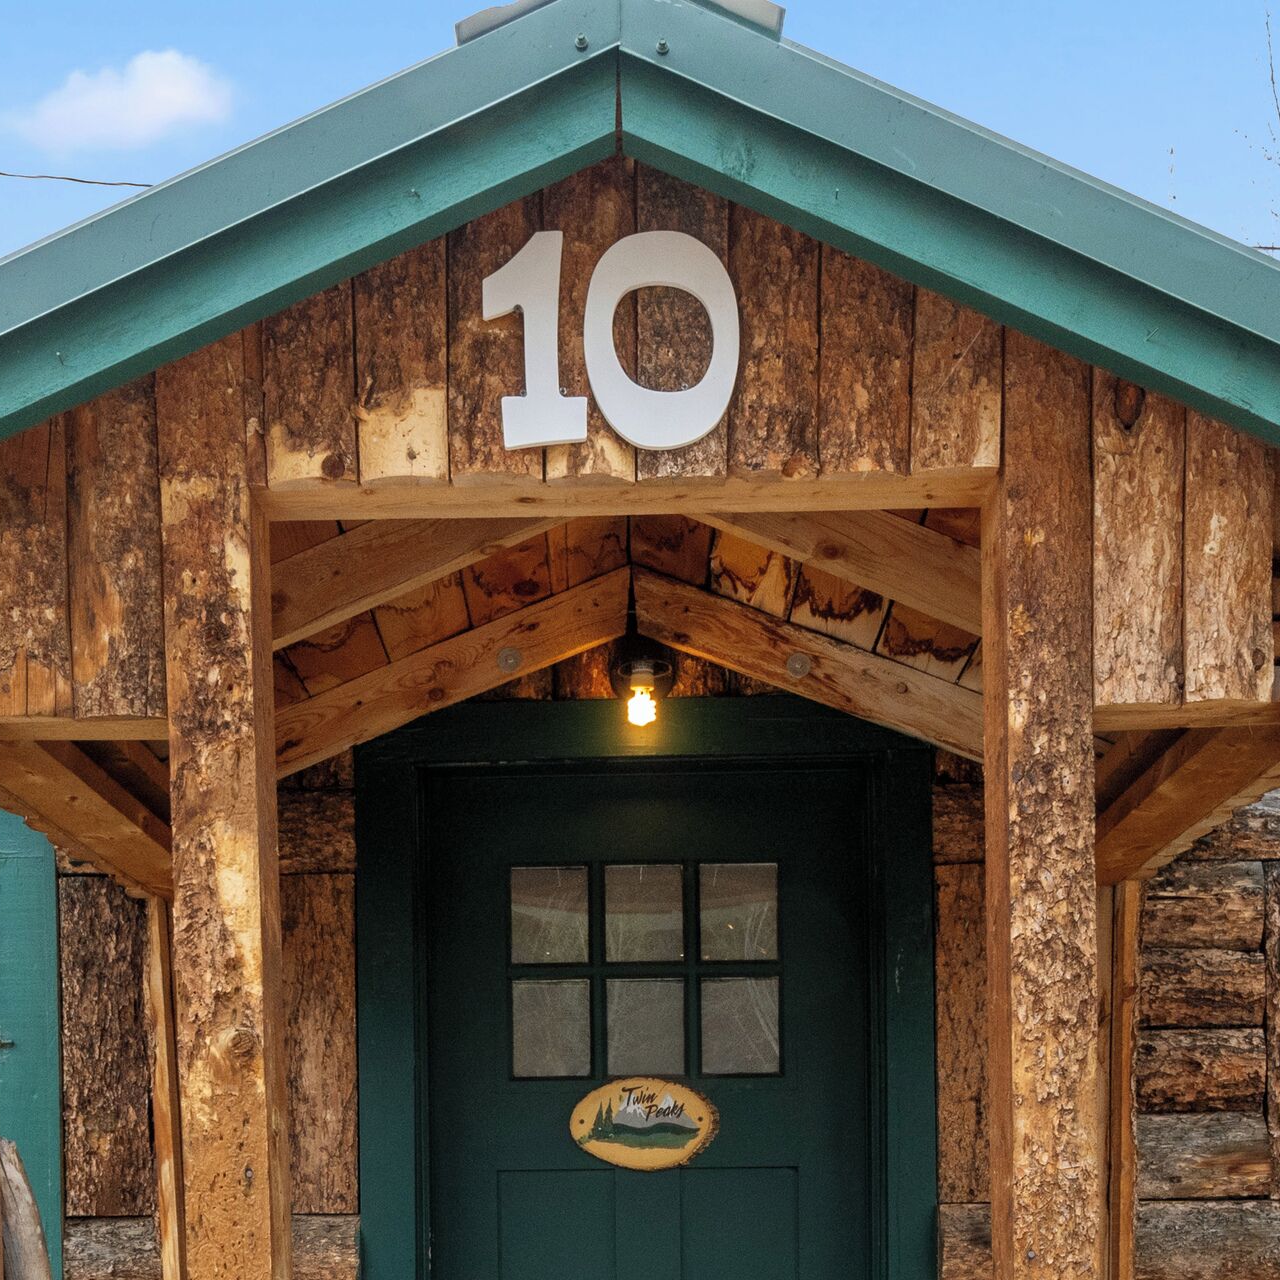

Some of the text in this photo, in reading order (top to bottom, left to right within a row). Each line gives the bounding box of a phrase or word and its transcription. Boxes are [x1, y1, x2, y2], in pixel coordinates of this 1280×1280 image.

[482, 230, 740, 450] 10
[621, 1085, 658, 1107] Twin
[645, 1100, 686, 1122] Peaks
